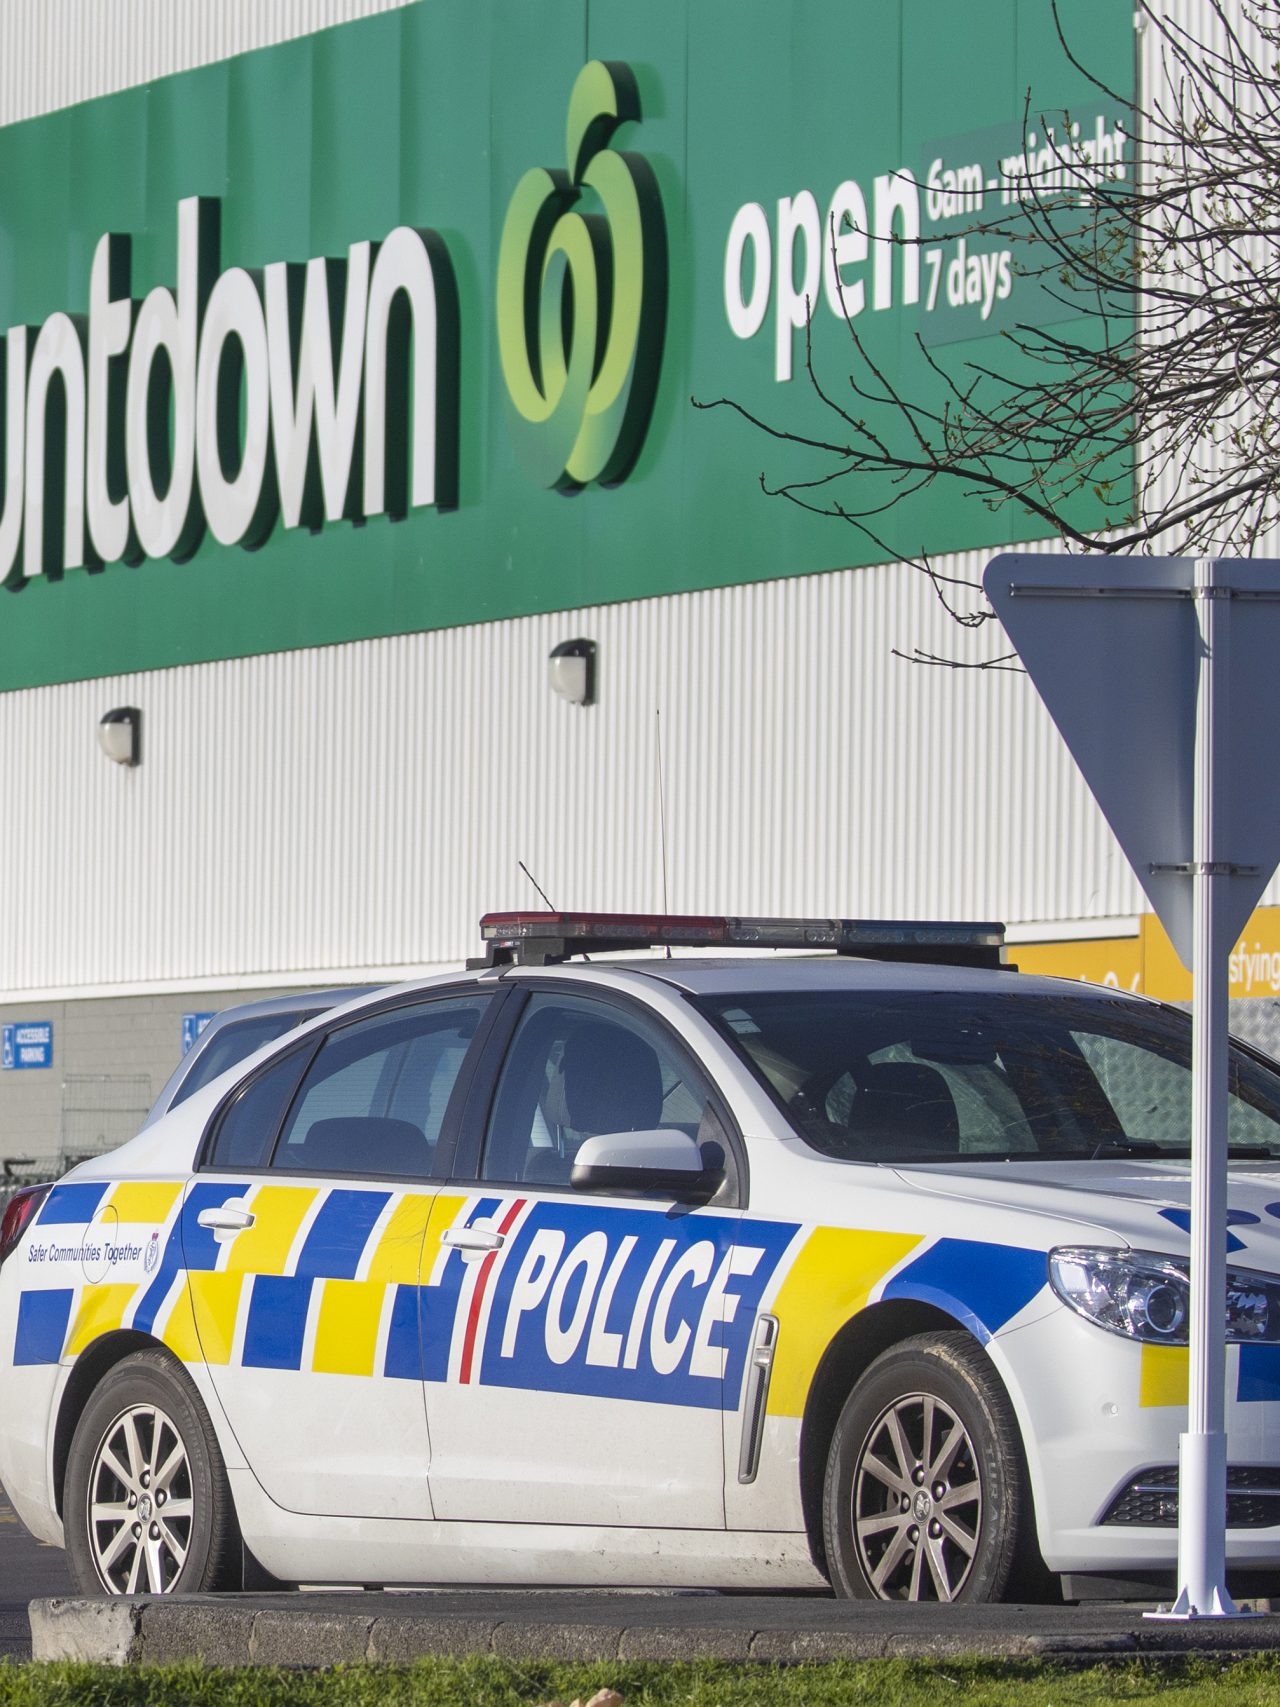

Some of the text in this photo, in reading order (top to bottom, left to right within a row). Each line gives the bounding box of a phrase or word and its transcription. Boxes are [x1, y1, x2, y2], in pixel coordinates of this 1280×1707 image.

[926, 157, 984, 222] 6am
[1001, 115, 1127, 207] midnight
[724, 167, 920, 383] open
[925, 238, 1013, 321] 7 days
[1229, 942, 1280, 992] sfying
[28, 1242, 143, 1265] Safer Communities Together
[500, 1228, 766, 1380] POLICE
